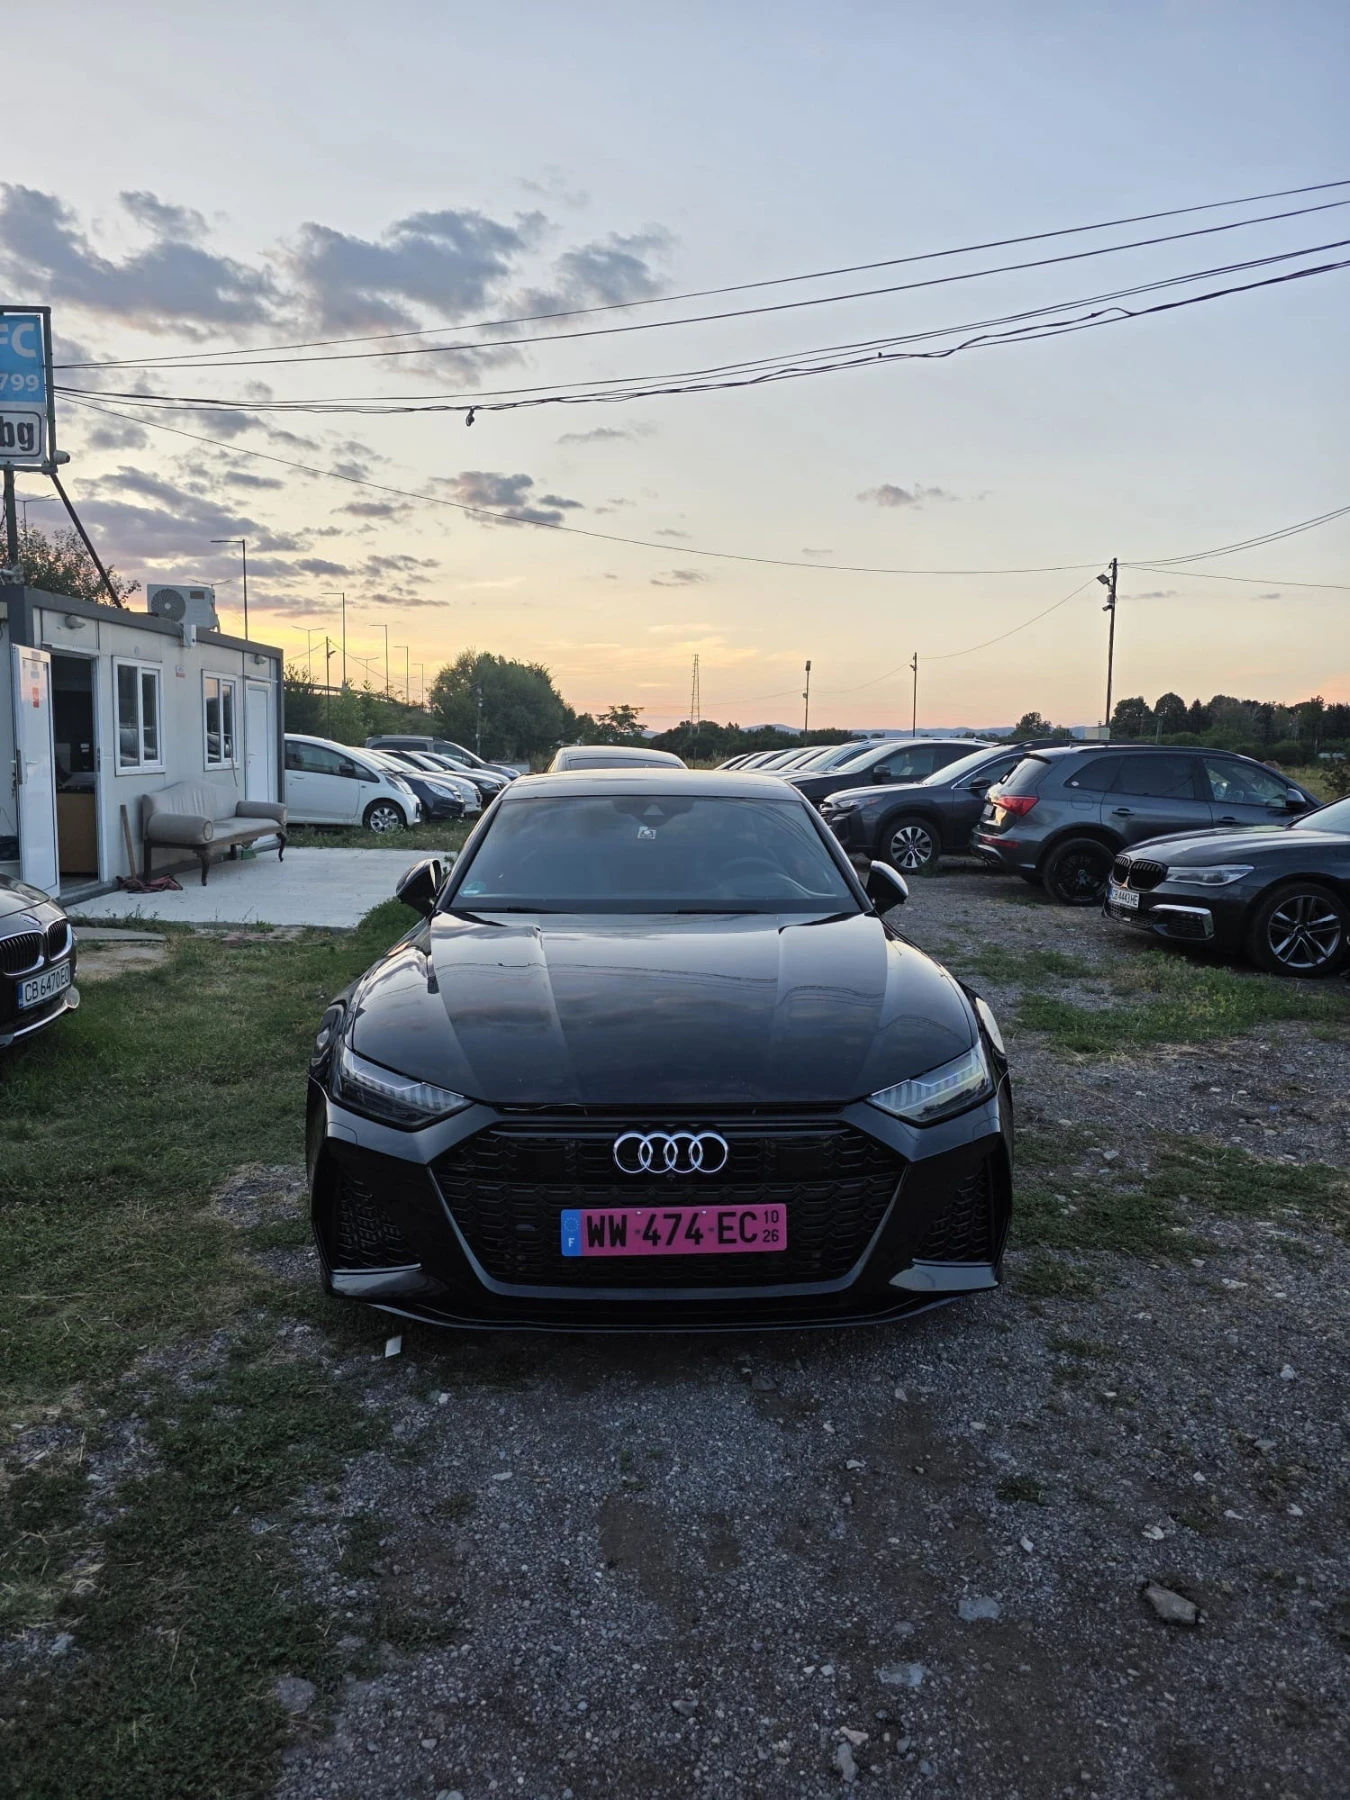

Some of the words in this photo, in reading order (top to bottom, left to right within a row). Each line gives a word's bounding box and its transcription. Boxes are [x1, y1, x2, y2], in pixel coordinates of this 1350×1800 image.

[764, 1210, 779, 1224] 10
[568, 1237, 576, 1248] F
[762, 1229, 779, 1243] 26
